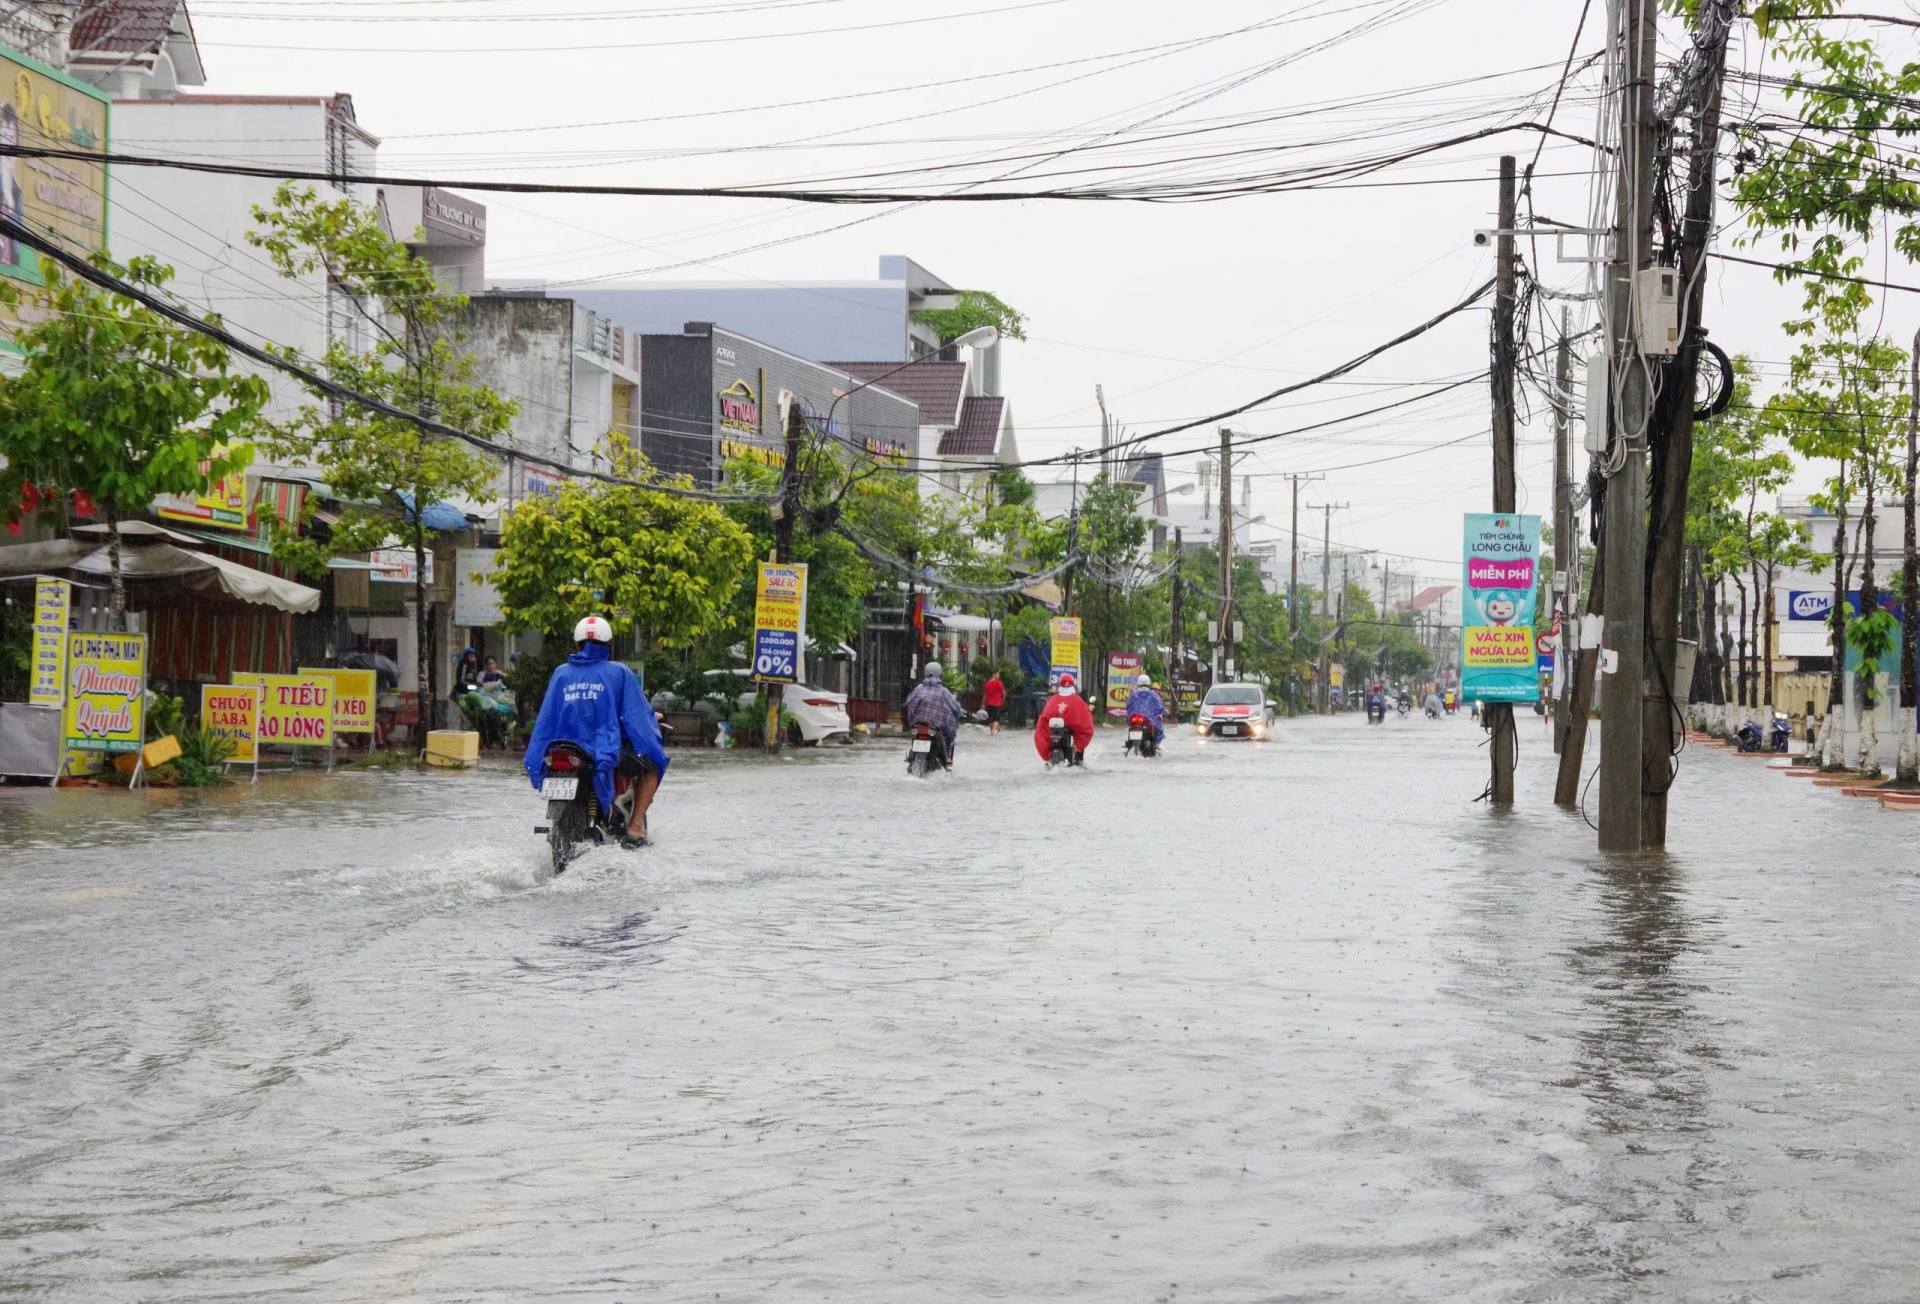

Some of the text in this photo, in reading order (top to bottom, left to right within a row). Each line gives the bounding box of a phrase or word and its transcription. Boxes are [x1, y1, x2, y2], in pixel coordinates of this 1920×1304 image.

[722, 398, 757, 423] VIETNAM
[1480, 532, 1496, 540] TIÊM
[1472, 541, 1532, 553] LONG CHÂU
[1471, 564, 1530, 580] MIỄN PHÍ
[768, 578, 785, 587] SALE
[1799, 597, 1828, 608] ATM
[1505, 632, 1525, 642] XIN
[1470, 644, 1529, 656] NGỪA LAO
[757, 655, 792, 675] 0%
[72, 663, 141, 701] Phương
[208, 692, 252, 710] CHUỐI
[276, 681, 327, 706] TIẾU
[1181, 692, 1198, 700] ANH
[343, 695, 366, 716] XÈO
[77, 700, 132, 737] Quỳnh
[211, 711, 248, 726] LABA
[259, 709, 325, 739] ÁO LÒNG
